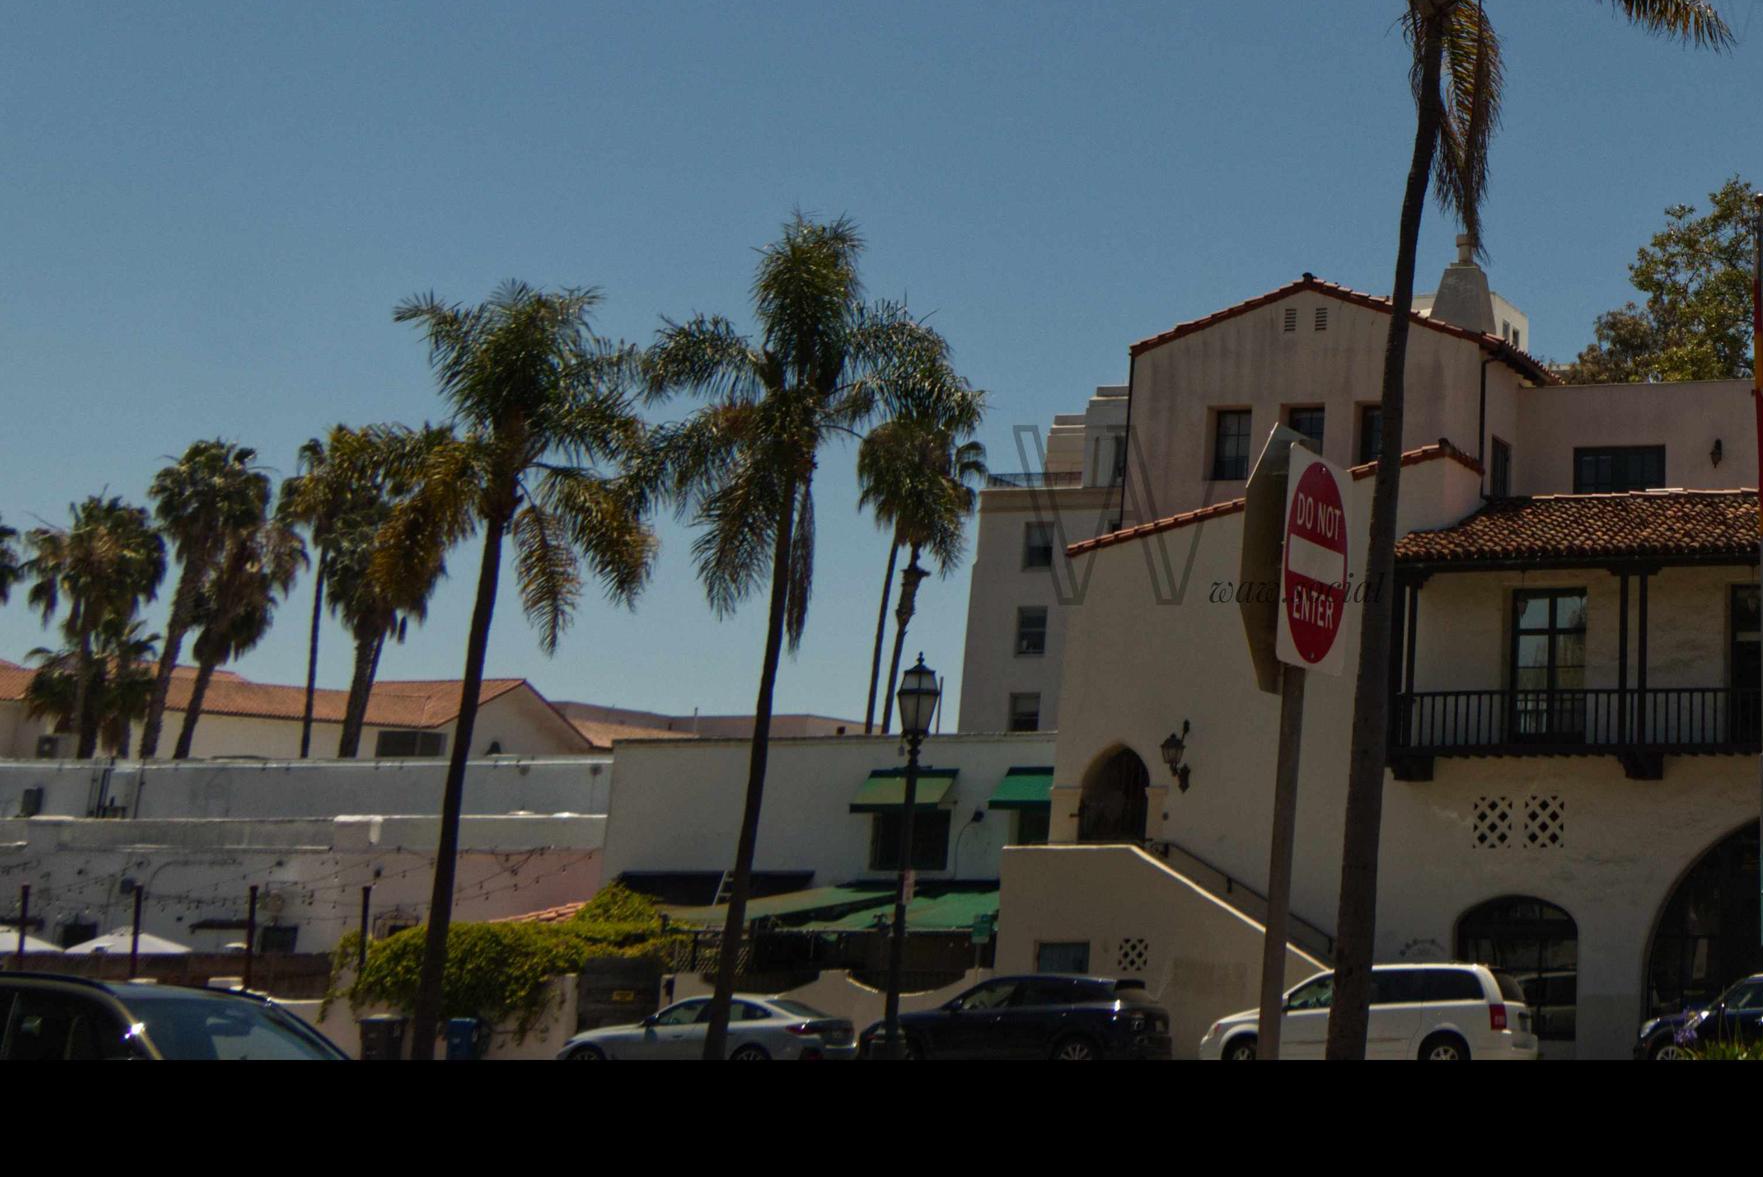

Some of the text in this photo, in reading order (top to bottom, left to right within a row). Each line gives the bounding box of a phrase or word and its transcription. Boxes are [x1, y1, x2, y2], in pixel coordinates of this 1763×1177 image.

[1296, 493, 1342, 541] DO NOT
[1292, 585, 1335, 630] ENTER
